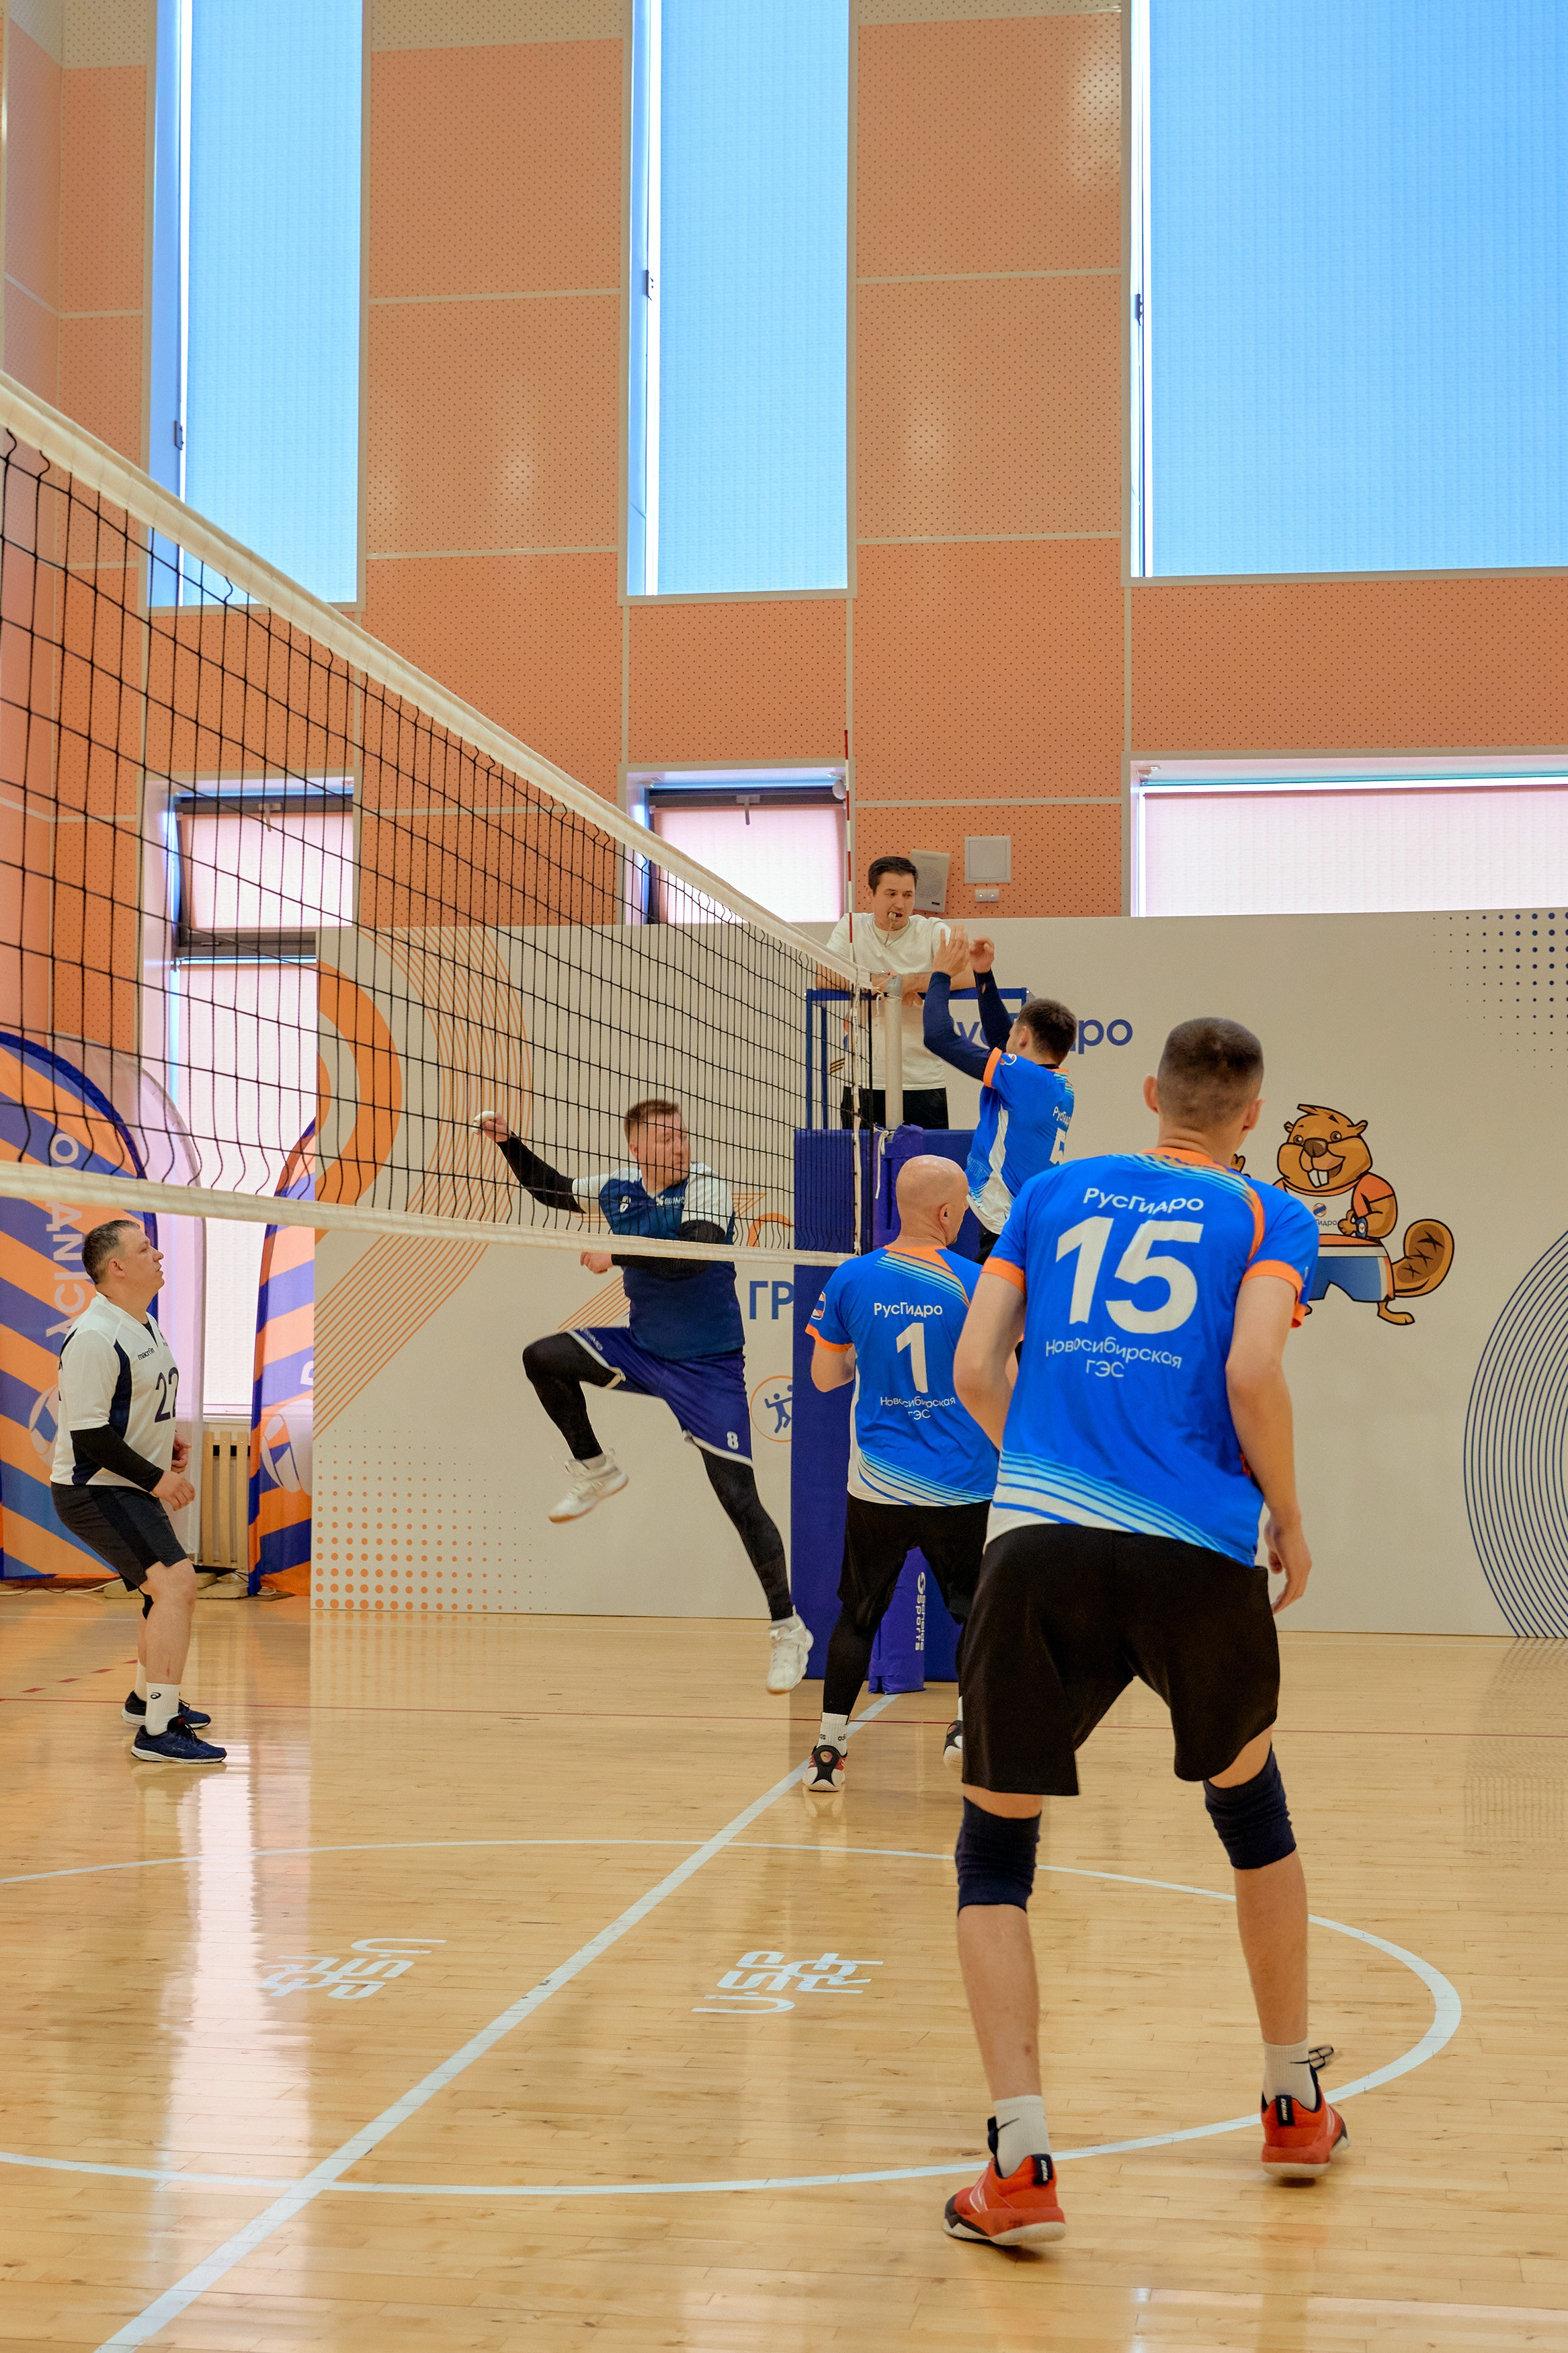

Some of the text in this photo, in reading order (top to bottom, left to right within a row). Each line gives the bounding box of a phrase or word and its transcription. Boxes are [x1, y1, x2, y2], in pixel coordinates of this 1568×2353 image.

[1083, 1187, 1204, 1215] РусГидро
[1055, 1215, 1204, 1334] 15
[874, 1302, 943, 1318] РусГидро
[896, 1322, 928, 1393] 1
[1046, 1337, 1183, 1369] Новосибирская
[1086, 1359, 1124, 1378] ГЭС
[727, 1431, 739, 1450] 8
